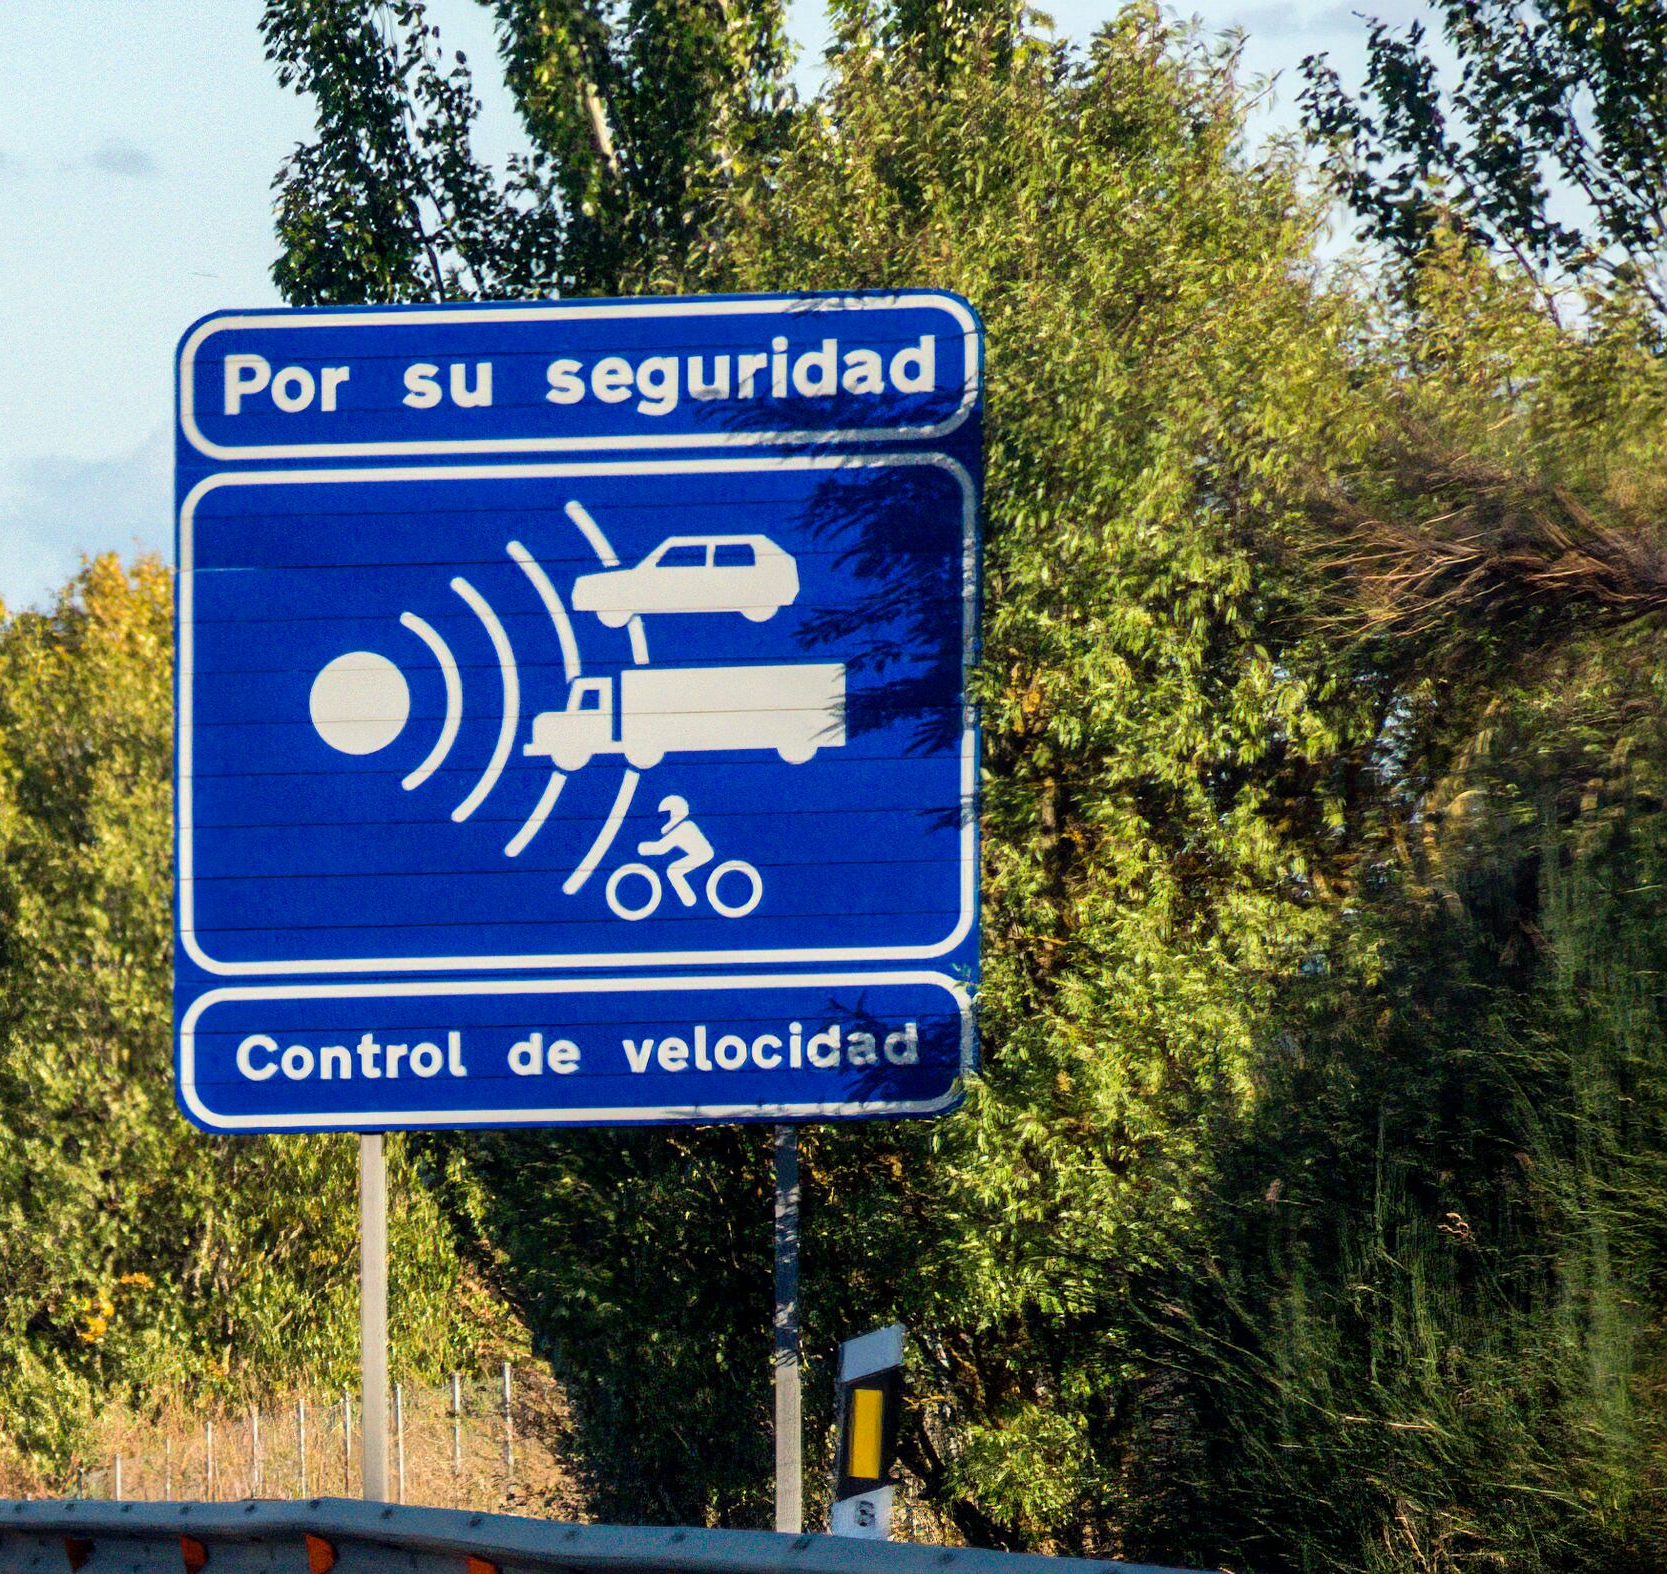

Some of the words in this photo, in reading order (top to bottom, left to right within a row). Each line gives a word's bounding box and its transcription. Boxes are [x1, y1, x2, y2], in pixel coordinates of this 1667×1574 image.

[224, 353, 350, 416] Por
[402, 362, 493, 409] su
[545, 334, 936, 417] seguridad
[236, 1031, 467, 1082] Control
[507, 1032, 581, 1076] de
[621, 1022, 919, 1074] velocidad
